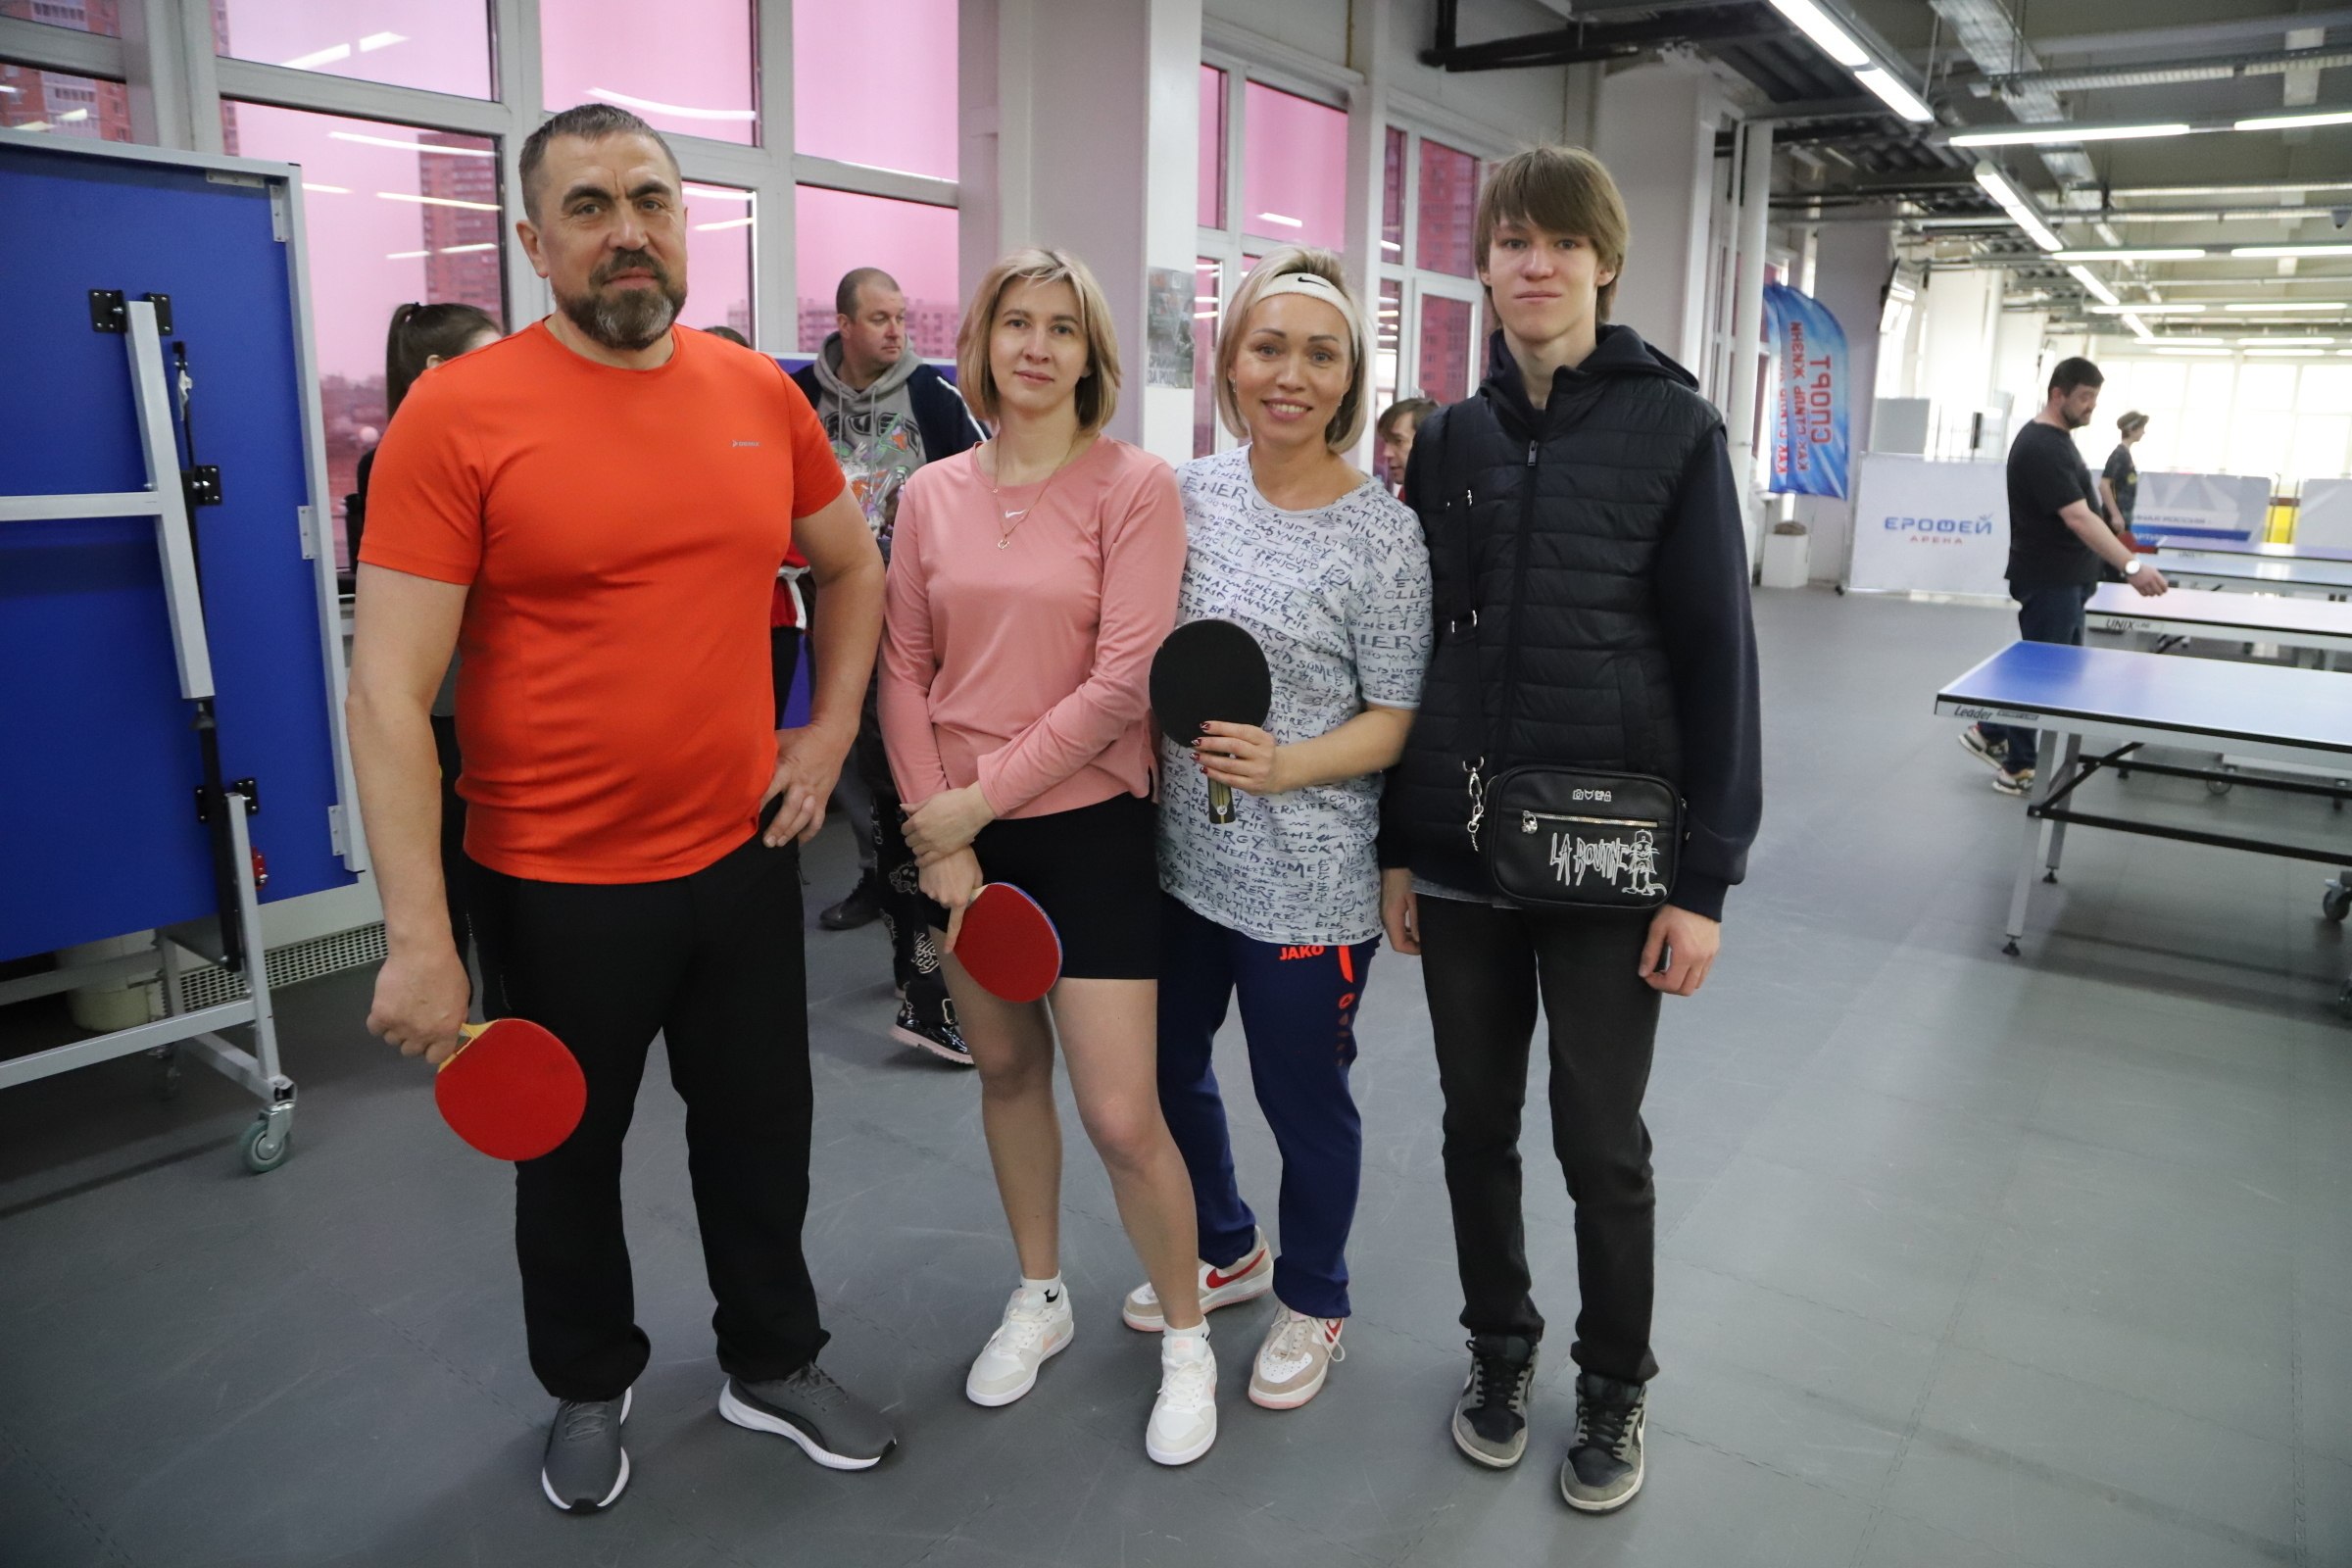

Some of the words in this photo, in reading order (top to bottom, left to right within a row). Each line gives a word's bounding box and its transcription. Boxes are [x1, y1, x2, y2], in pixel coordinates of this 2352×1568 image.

[1885, 514, 1992, 535] ЕРОФЕЙ
[1910, 534, 1963, 545] АРЕНА
[1954, 705, 1993, 720] Leader
[1549, 832, 1573, 887] LA
[1280, 944, 1325, 960] JAKO
